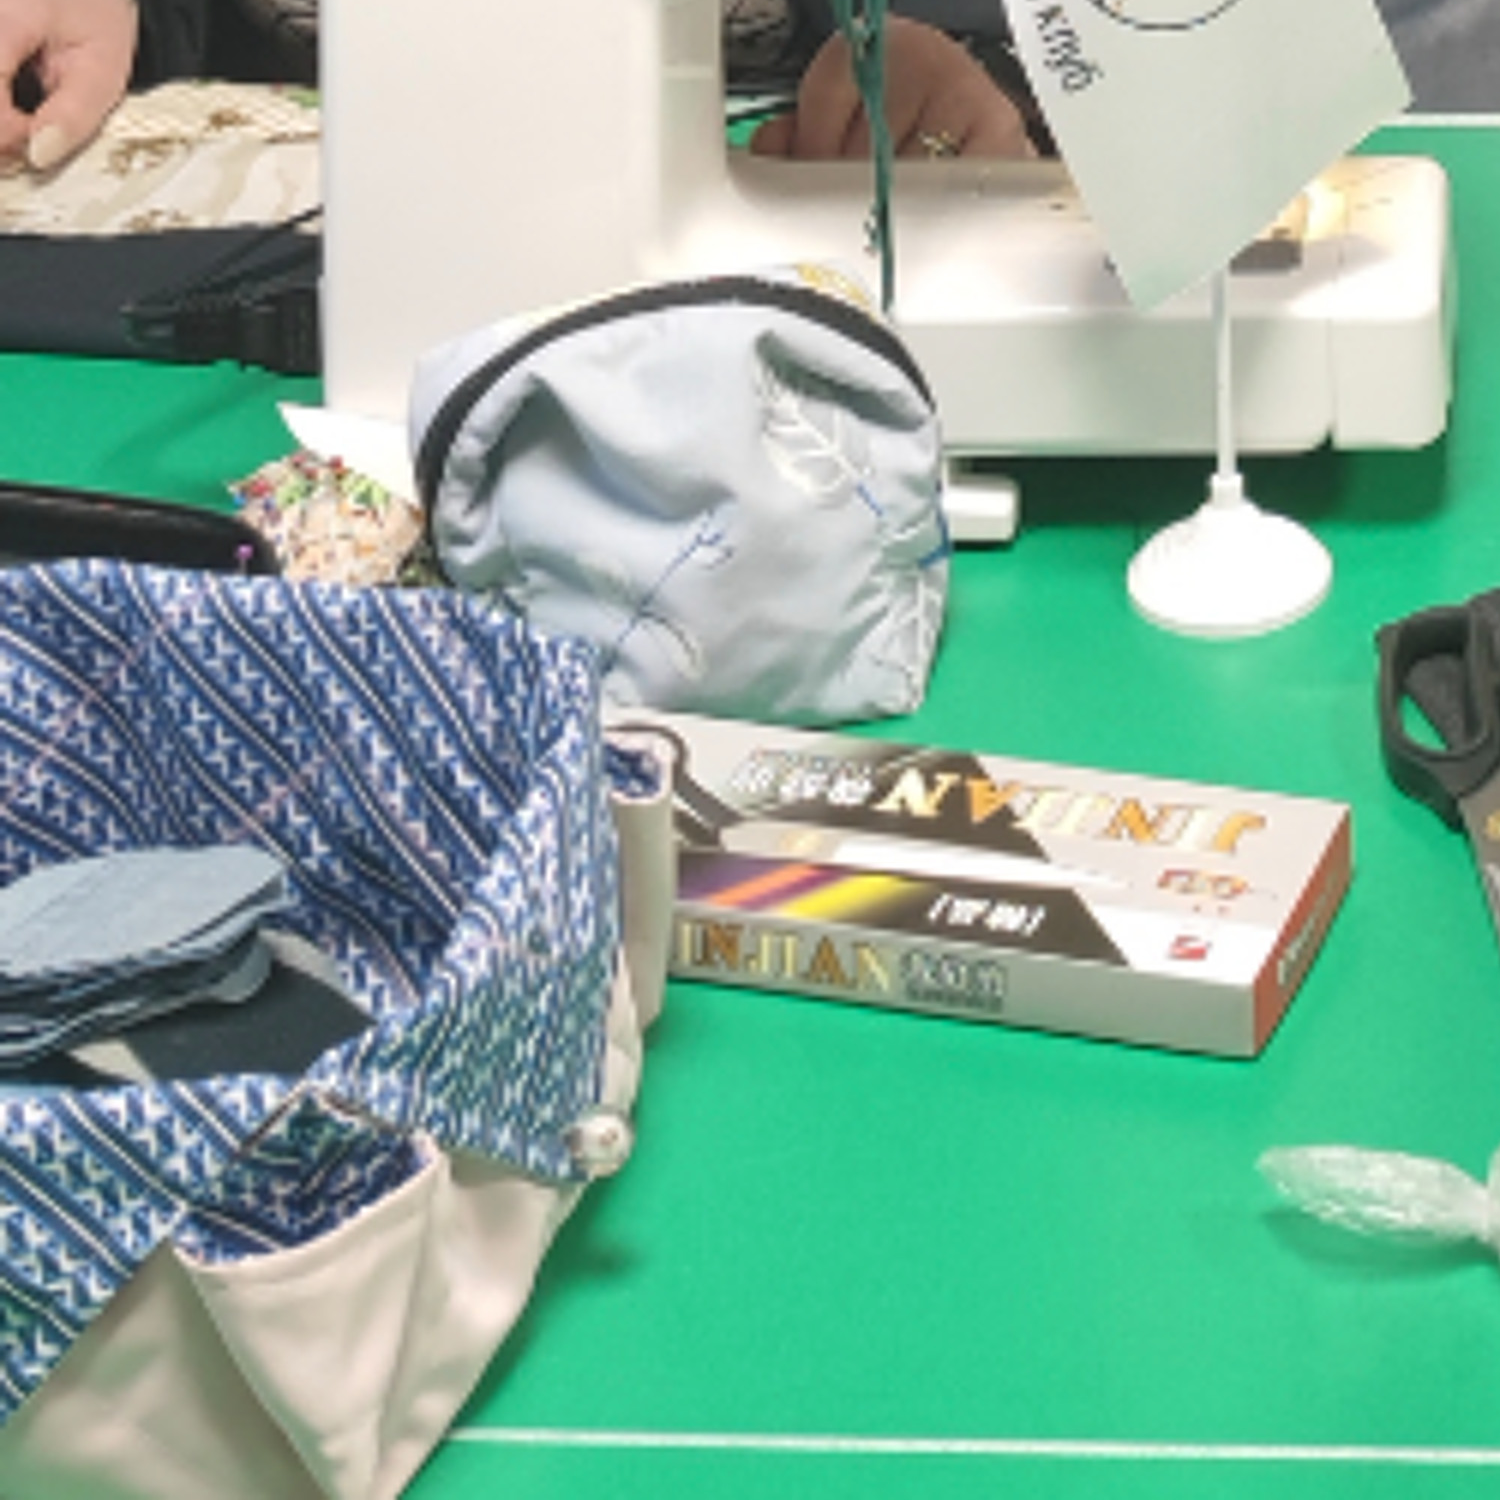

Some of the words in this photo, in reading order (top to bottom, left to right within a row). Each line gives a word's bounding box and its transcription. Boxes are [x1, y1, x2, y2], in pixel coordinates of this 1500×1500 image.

[1035, 4, 1104, 94] клуб
[872, 767, 1267, 856] JINJIAN
[676, 912, 894, 984] INJIAN
